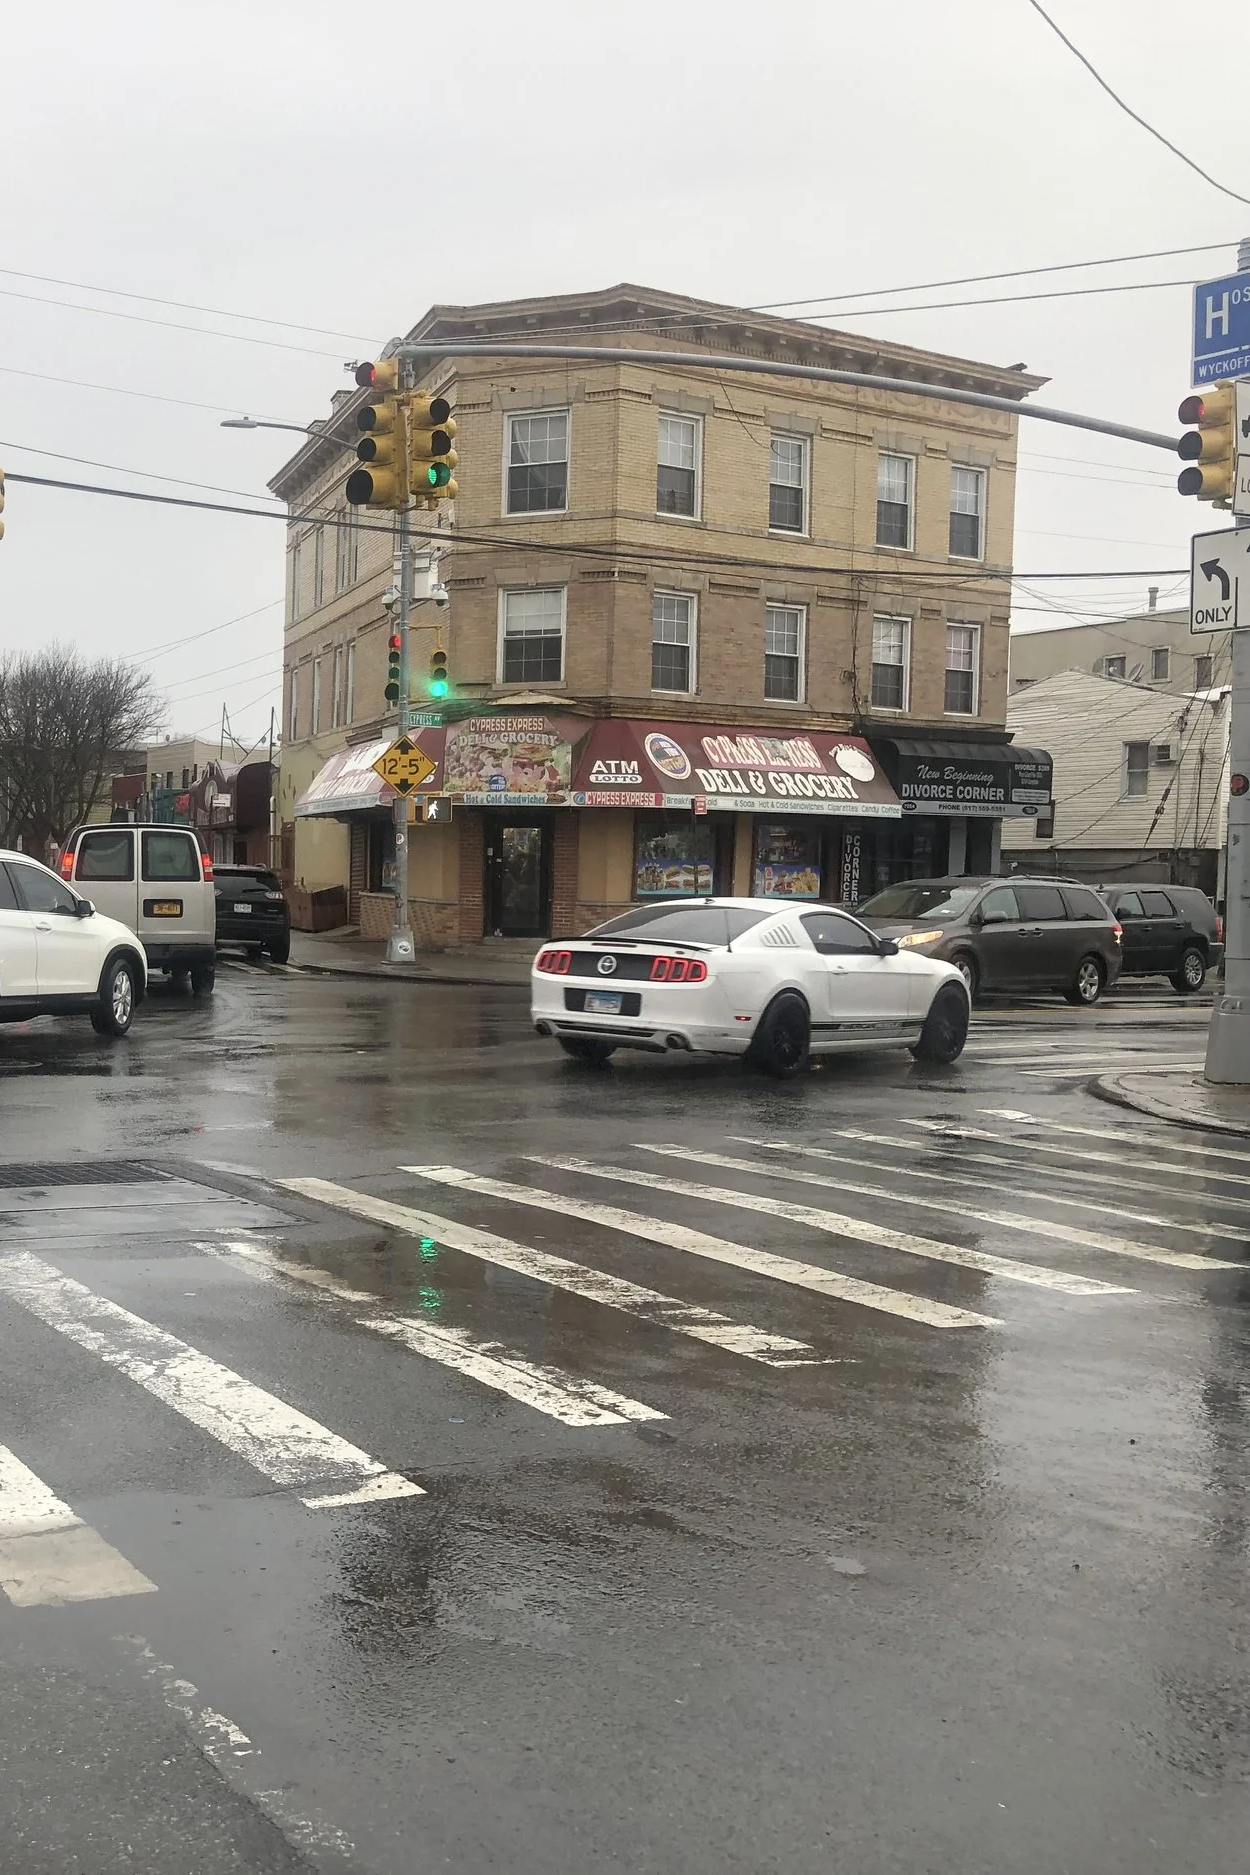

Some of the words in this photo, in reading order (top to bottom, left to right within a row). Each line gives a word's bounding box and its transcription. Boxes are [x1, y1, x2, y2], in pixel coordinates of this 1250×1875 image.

[1198, 355, 1250, 377] WYCKOFF
[1195, 606, 1232, 625] ONLY
[410, 714, 432, 725] CYPRESS
[470, 718, 505, 731] CYPRESS
[507, 717, 543, 731] EXPRESS
[458, 733, 488, 747] DELI
[489, 733, 498, 743] &
[500, 732, 557, 746] GROCERY
[702, 735, 766, 766] CYPRESS
[761, 740, 821, 768] ERESS
[382, 757, 425, 775] 12'-5"
[591, 760, 639, 773] ATM
[917, 764, 940, 779] New
[943, 766, 994, 786] Beginning
[695, 768, 750, 794] DELI
[748, 770, 767, 795] &
[768, 772, 860, 799] GROCERY
[902, 783, 954, 798] DIVORCE
[956, 786, 1005, 801] CORNER
[465, 794, 479, 804] Hot
[486, 794, 501, 803] Cold
[503, 794, 546, 804] Sandwiches
[586, 792, 620, 805] CYPRESS
[621, 793, 654, 805] EXPRESS
[739, 800, 755, 808] Soda
[771, 801, 775, 809] &
[775, 801, 789, 809] Cold
[790, 802, 824, 811] Sandwiches
[827, 804, 858, 812] Cigarettes
[861, 805, 879, 813] Candy
[881, 806, 899, 814] Coffee
[843, 834, 852, 901] DIVORCE
[851, 835, 860, 901] CORNER
